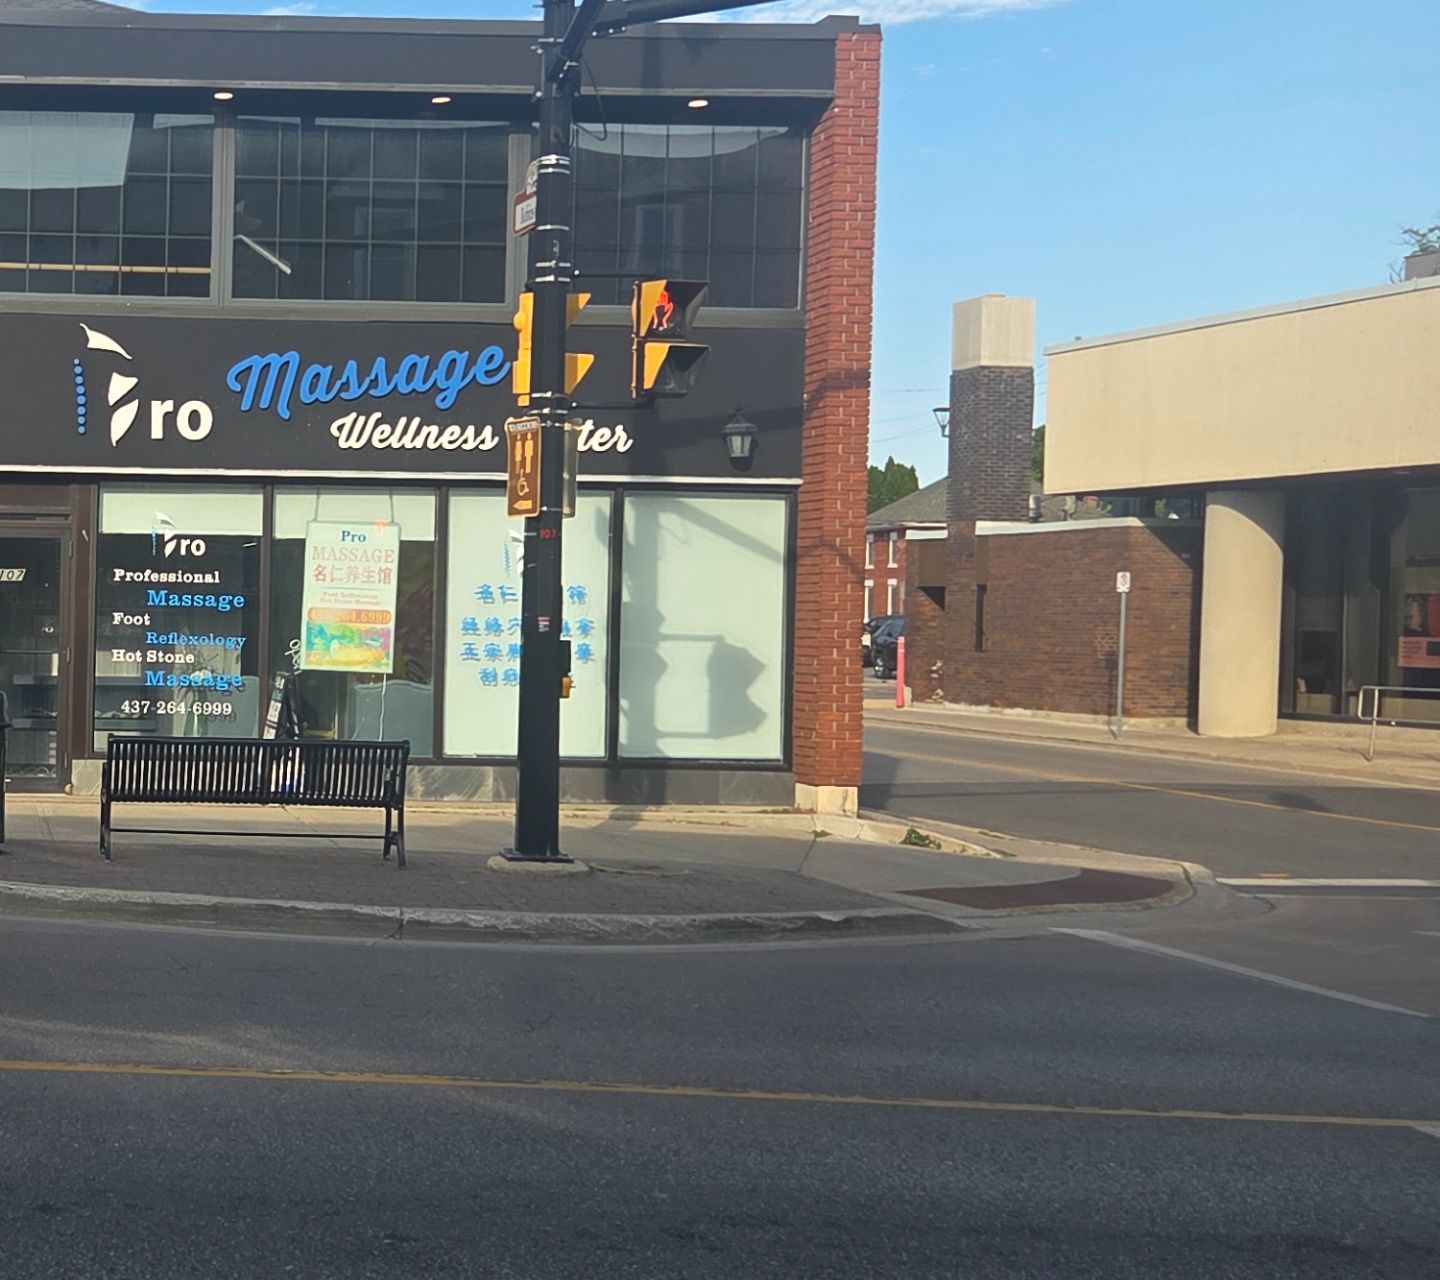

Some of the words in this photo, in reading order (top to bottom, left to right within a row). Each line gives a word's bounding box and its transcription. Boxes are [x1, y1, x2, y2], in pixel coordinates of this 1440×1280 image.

[227, 344, 510, 421] Massage
[330, 411, 499, 452] Wellness
[340, 529, 367, 543] Pro
[312, 545, 395, 564] MASSAGE
[112, 568, 220, 584] Professional
[146, 589, 245, 611] Massage
[111, 612, 151, 626] Foot
[145, 631, 247, 650] Reflexology
[111, 649, 143, 663] Hot
[146, 650, 195, 664] Stone
[144, 670, 244, 691] Massage
